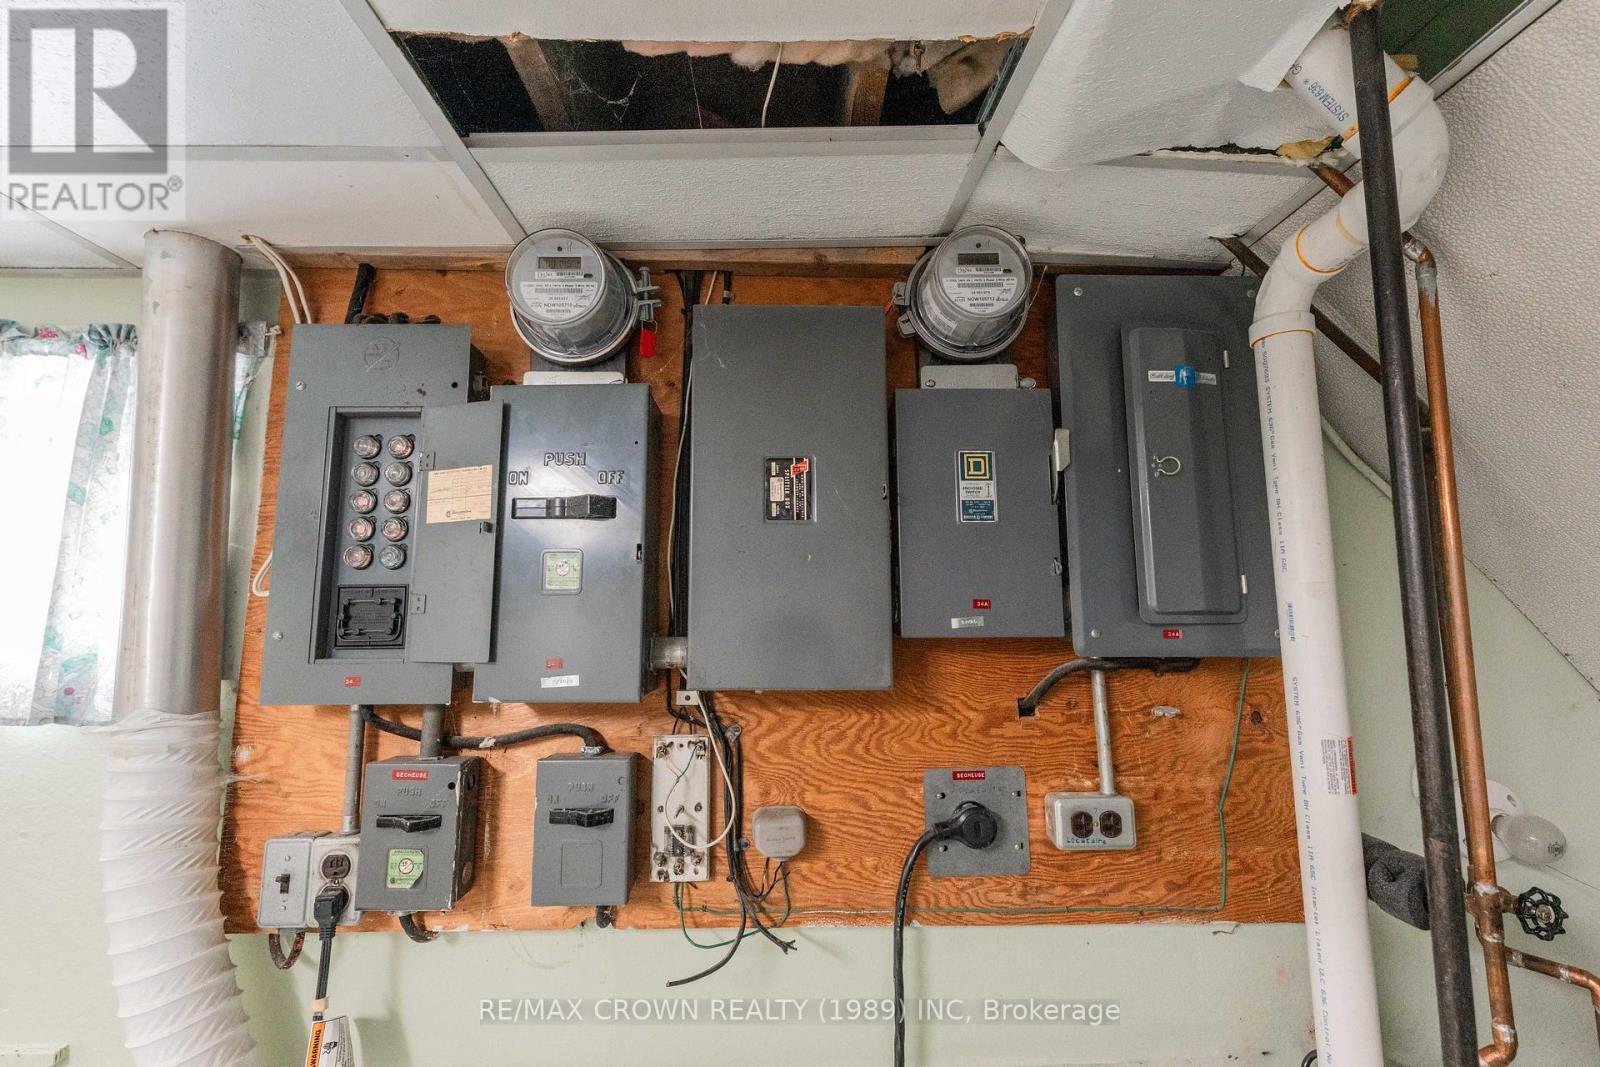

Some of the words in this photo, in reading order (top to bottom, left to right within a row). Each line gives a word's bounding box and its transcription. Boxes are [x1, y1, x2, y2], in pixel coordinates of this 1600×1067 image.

[544, 452, 587, 466] PUSH
[509, 471, 529, 485] ON
[597, 471, 625, 485] OFF
[1291, 676, 1300, 706] SYSTEM
[1303, 814, 1312, 840] Class
